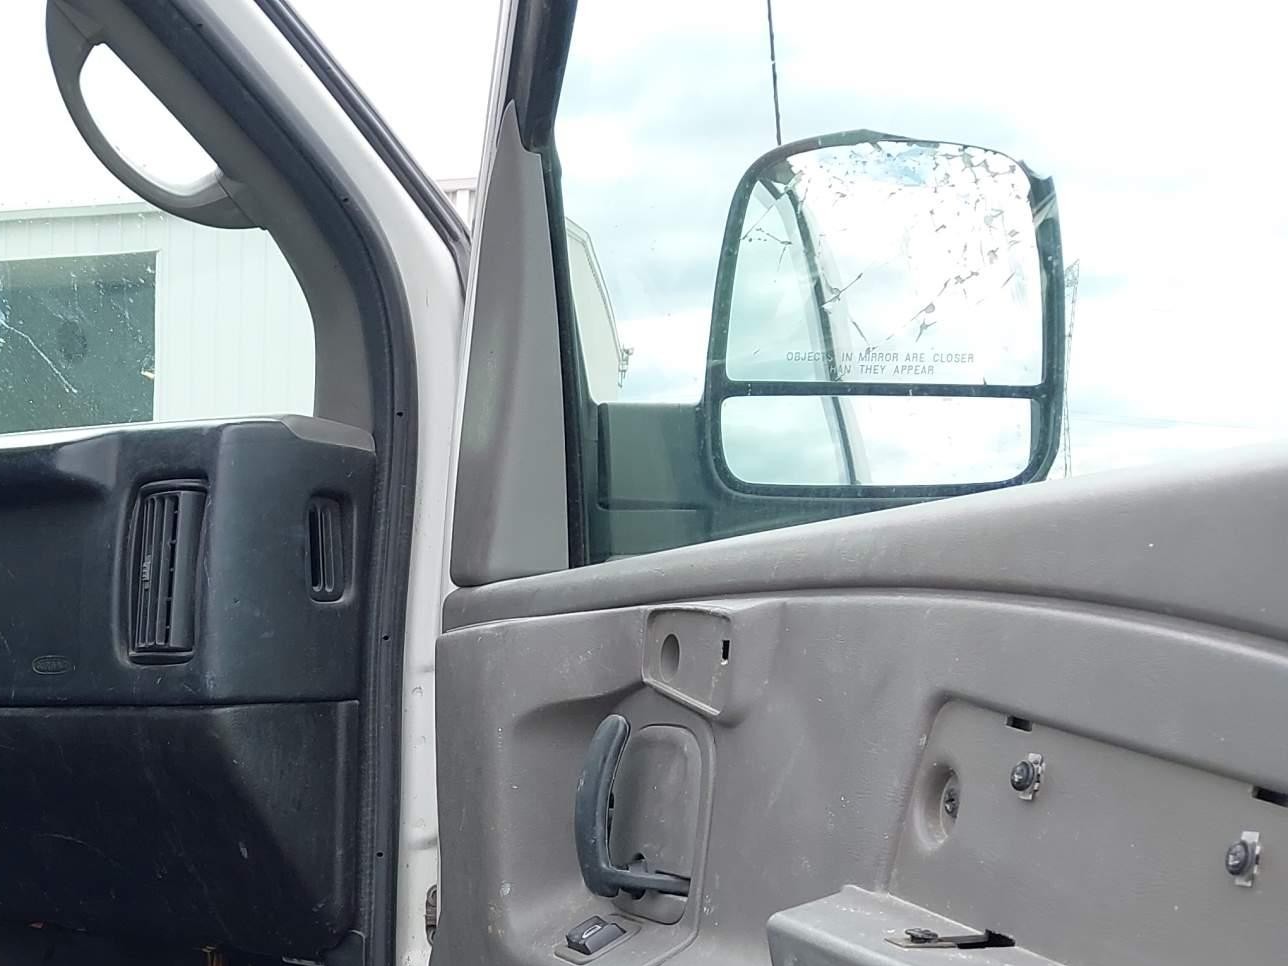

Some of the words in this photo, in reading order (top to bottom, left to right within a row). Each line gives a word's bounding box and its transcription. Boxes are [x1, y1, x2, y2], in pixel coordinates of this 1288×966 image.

[786, 351, 833, 362] OBJECTS
[841, 352, 853, 362] IN
[858, 352, 899, 362] MIRROR
[904, 352, 925, 363] ARE
[932, 353, 974, 363] CLOSER
[825, 364, 851, 374] HAN
[859, 364, 886, 375] THEY
[893, 365, 935, 375] APPEAR
